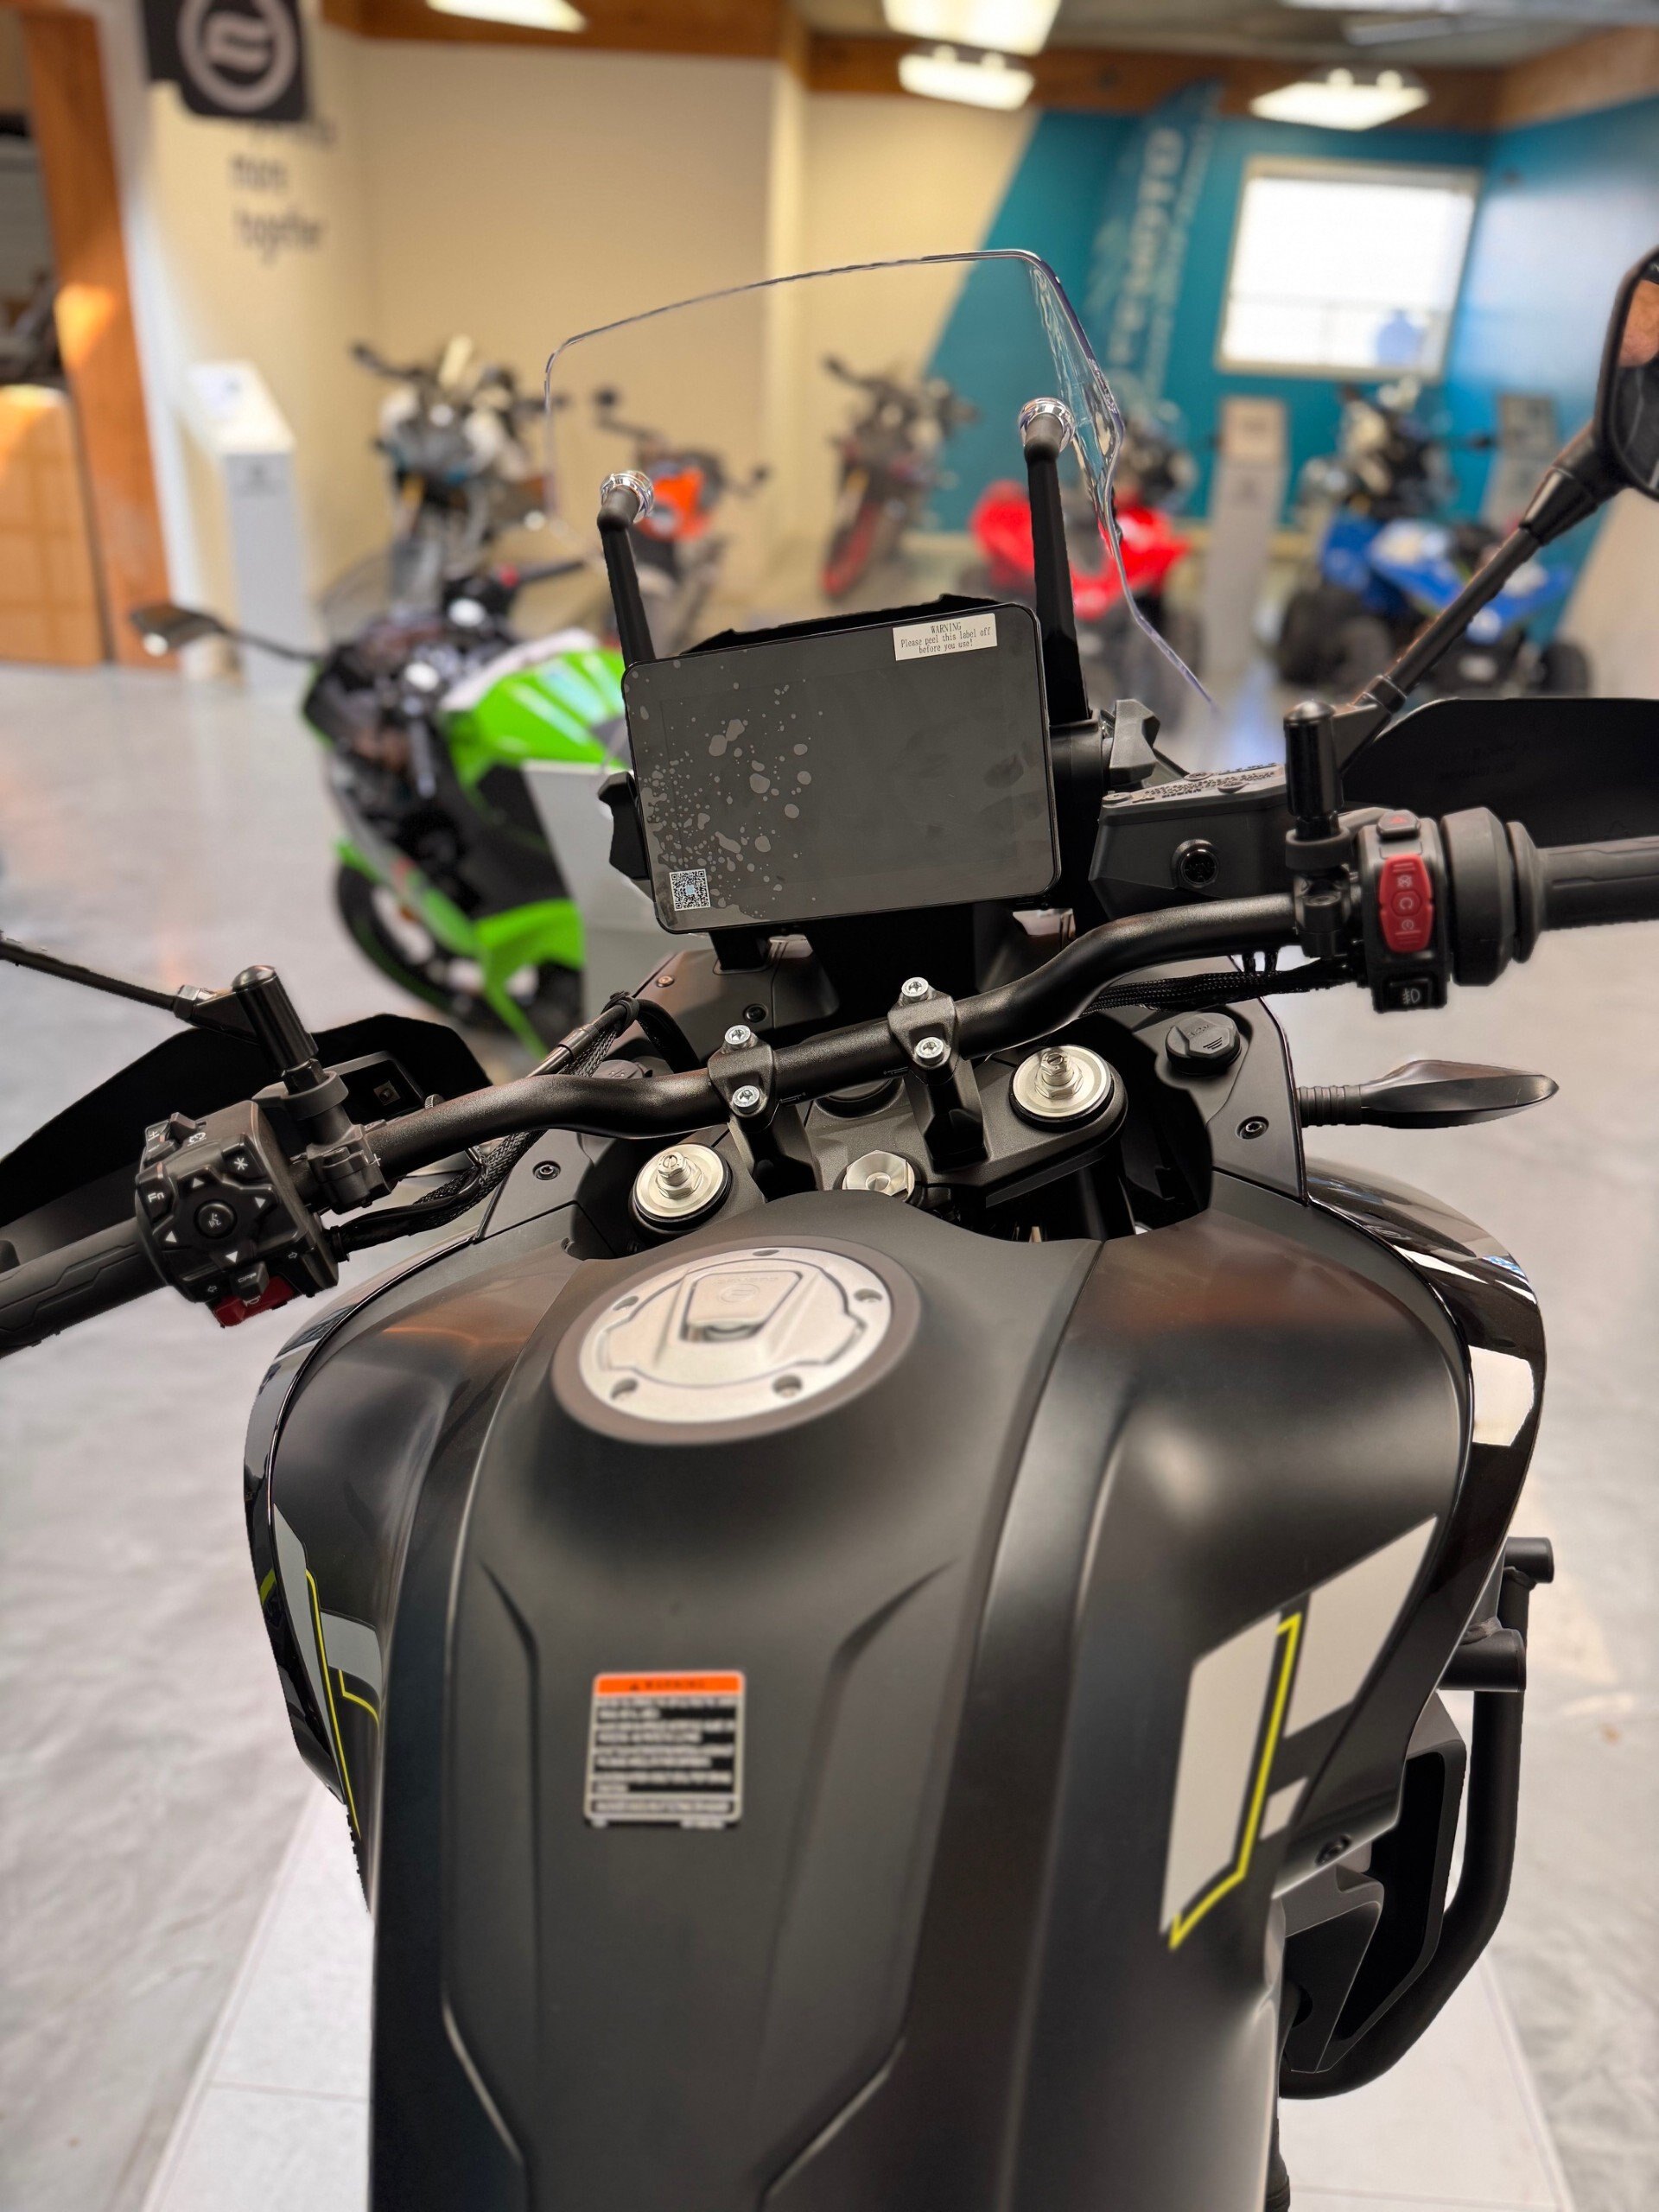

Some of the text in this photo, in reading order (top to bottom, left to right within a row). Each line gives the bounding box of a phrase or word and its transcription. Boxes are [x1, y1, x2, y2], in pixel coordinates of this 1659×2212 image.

[931, 622, 962, 633] WARNING
[900, 626, 991, 648] Please peel this label off
[918, 639, 973, 653] before you use!
[147, 1192, 164, 1203] Fn
